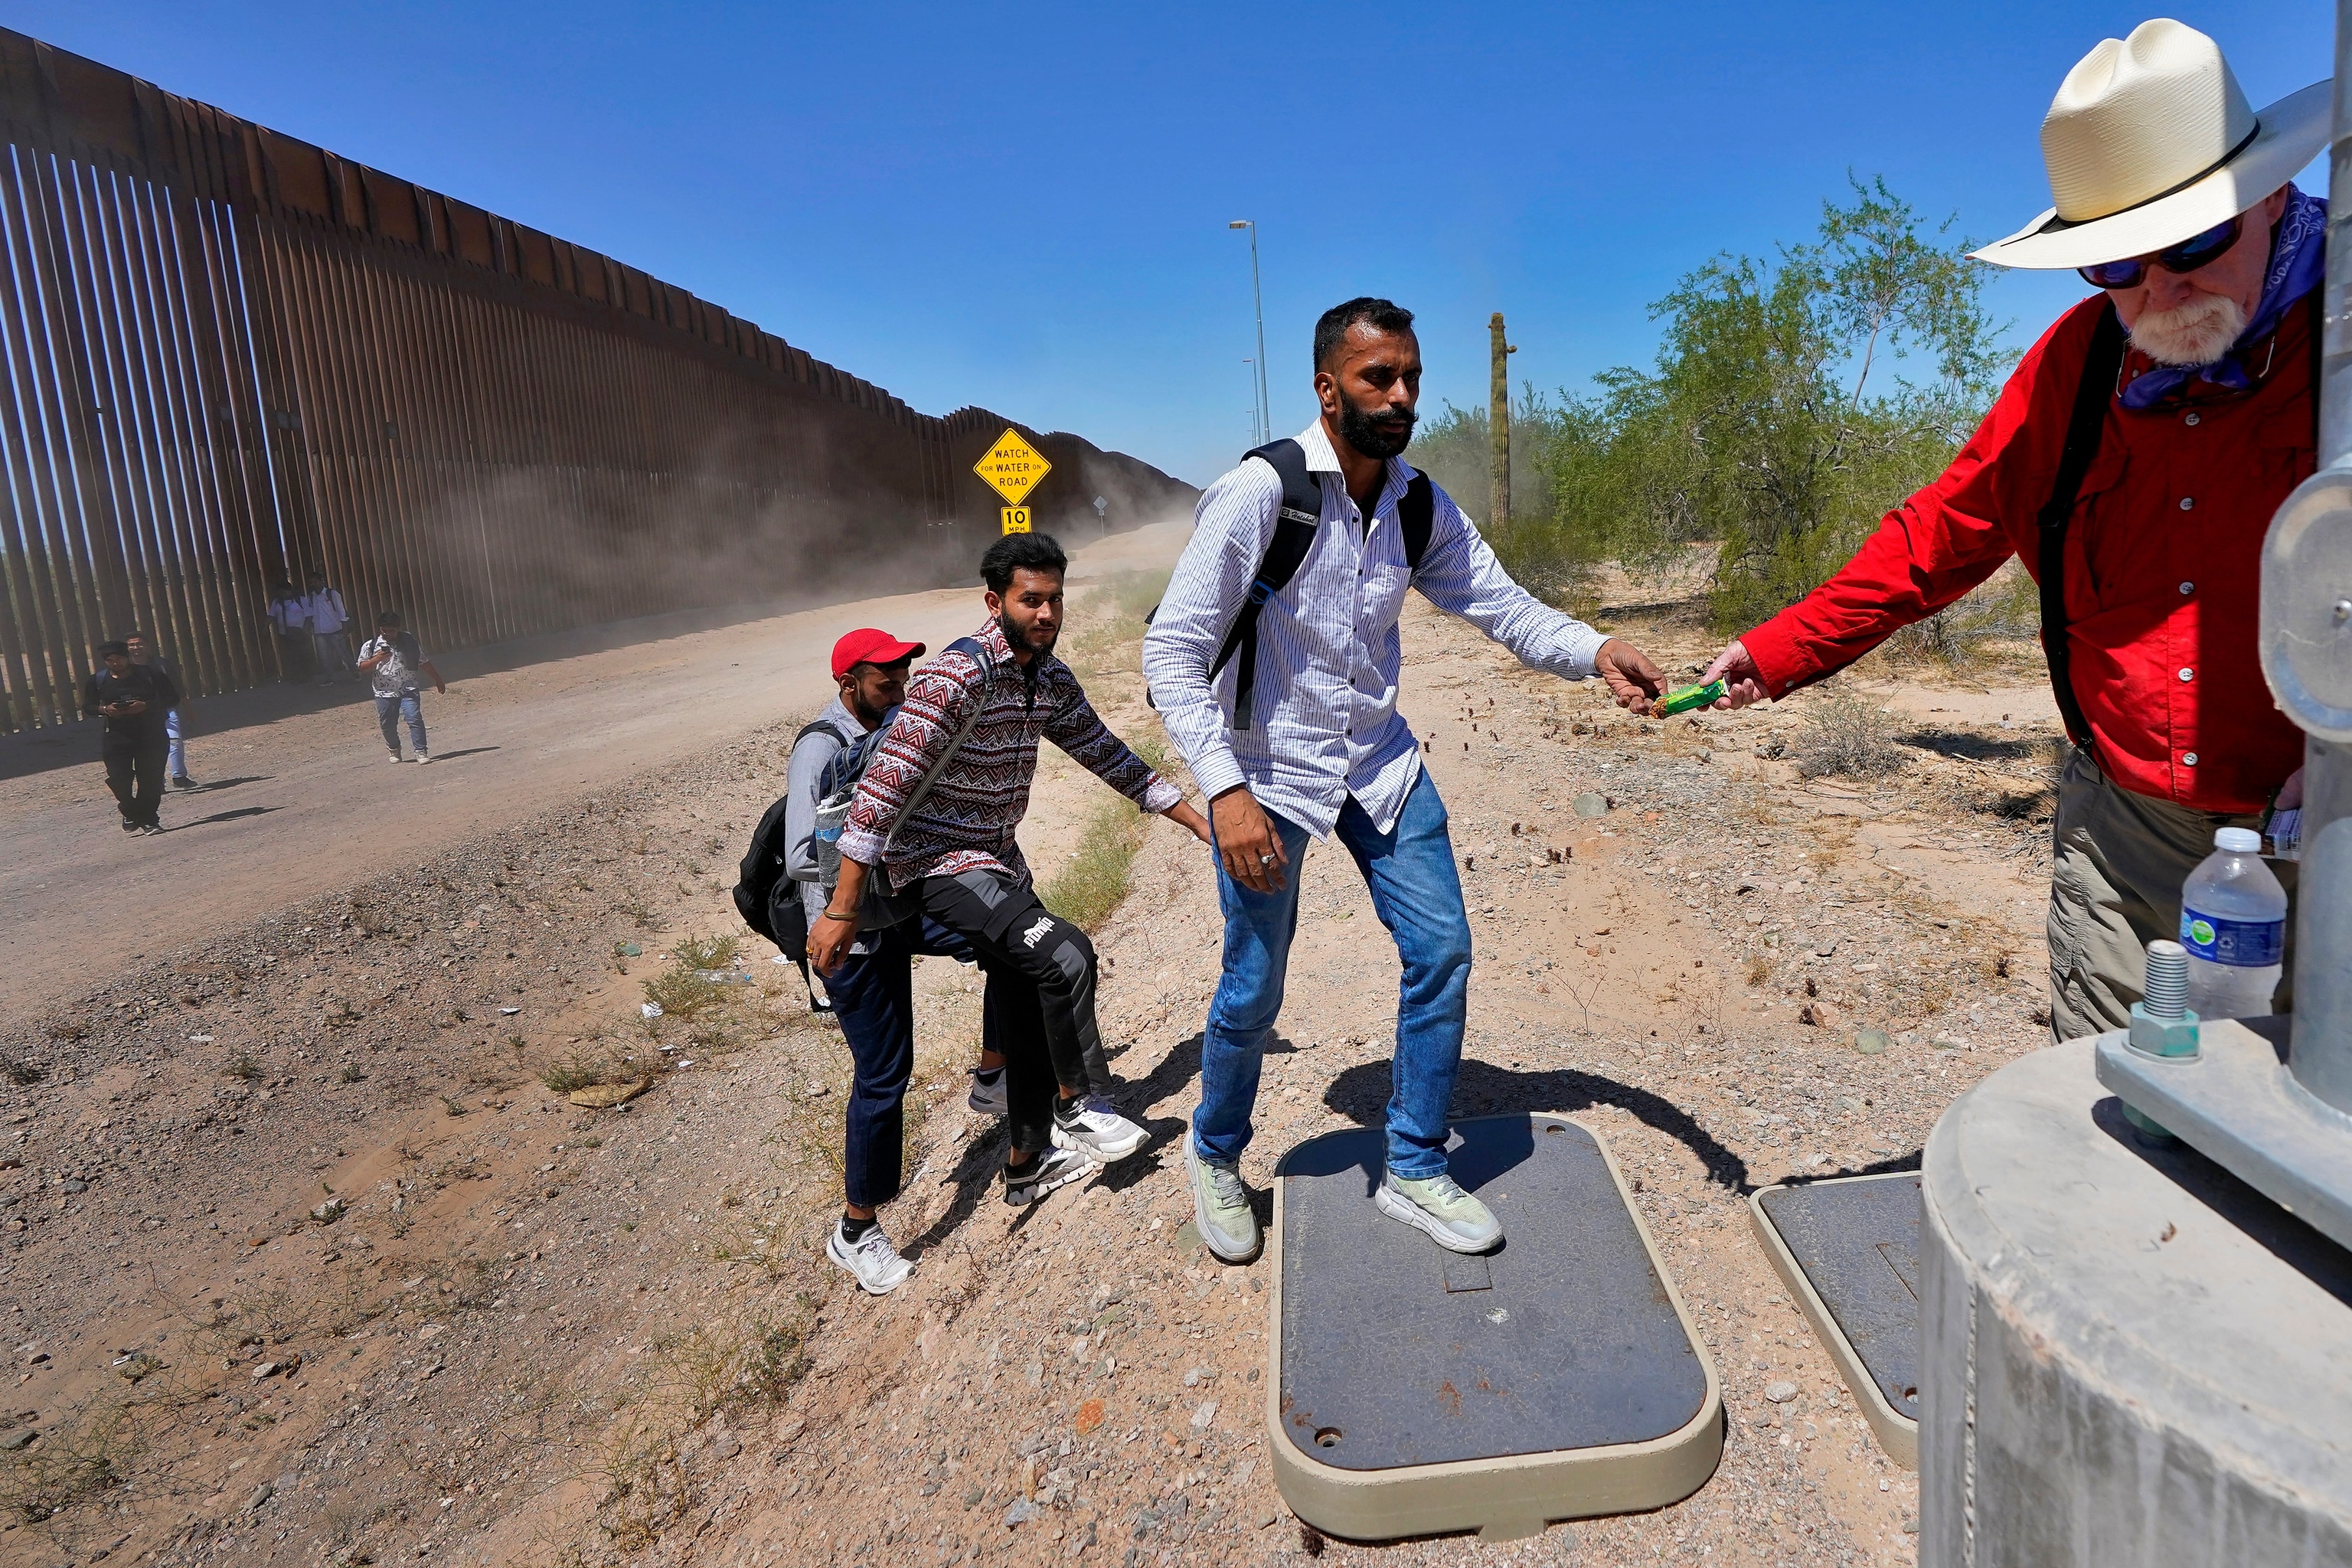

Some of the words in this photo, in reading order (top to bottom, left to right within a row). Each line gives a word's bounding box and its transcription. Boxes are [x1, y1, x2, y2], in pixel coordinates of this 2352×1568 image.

[995, 449, 1029, 459] WATCH
[996, 463, 1030, 472] WATER
[999, 477, 1028, 486] ROAD
[1006, 510, 1026, 524] 10
[1291, 511, 1316, 524] Hotshot
[1023, 916, 1056, 949] PUMA
